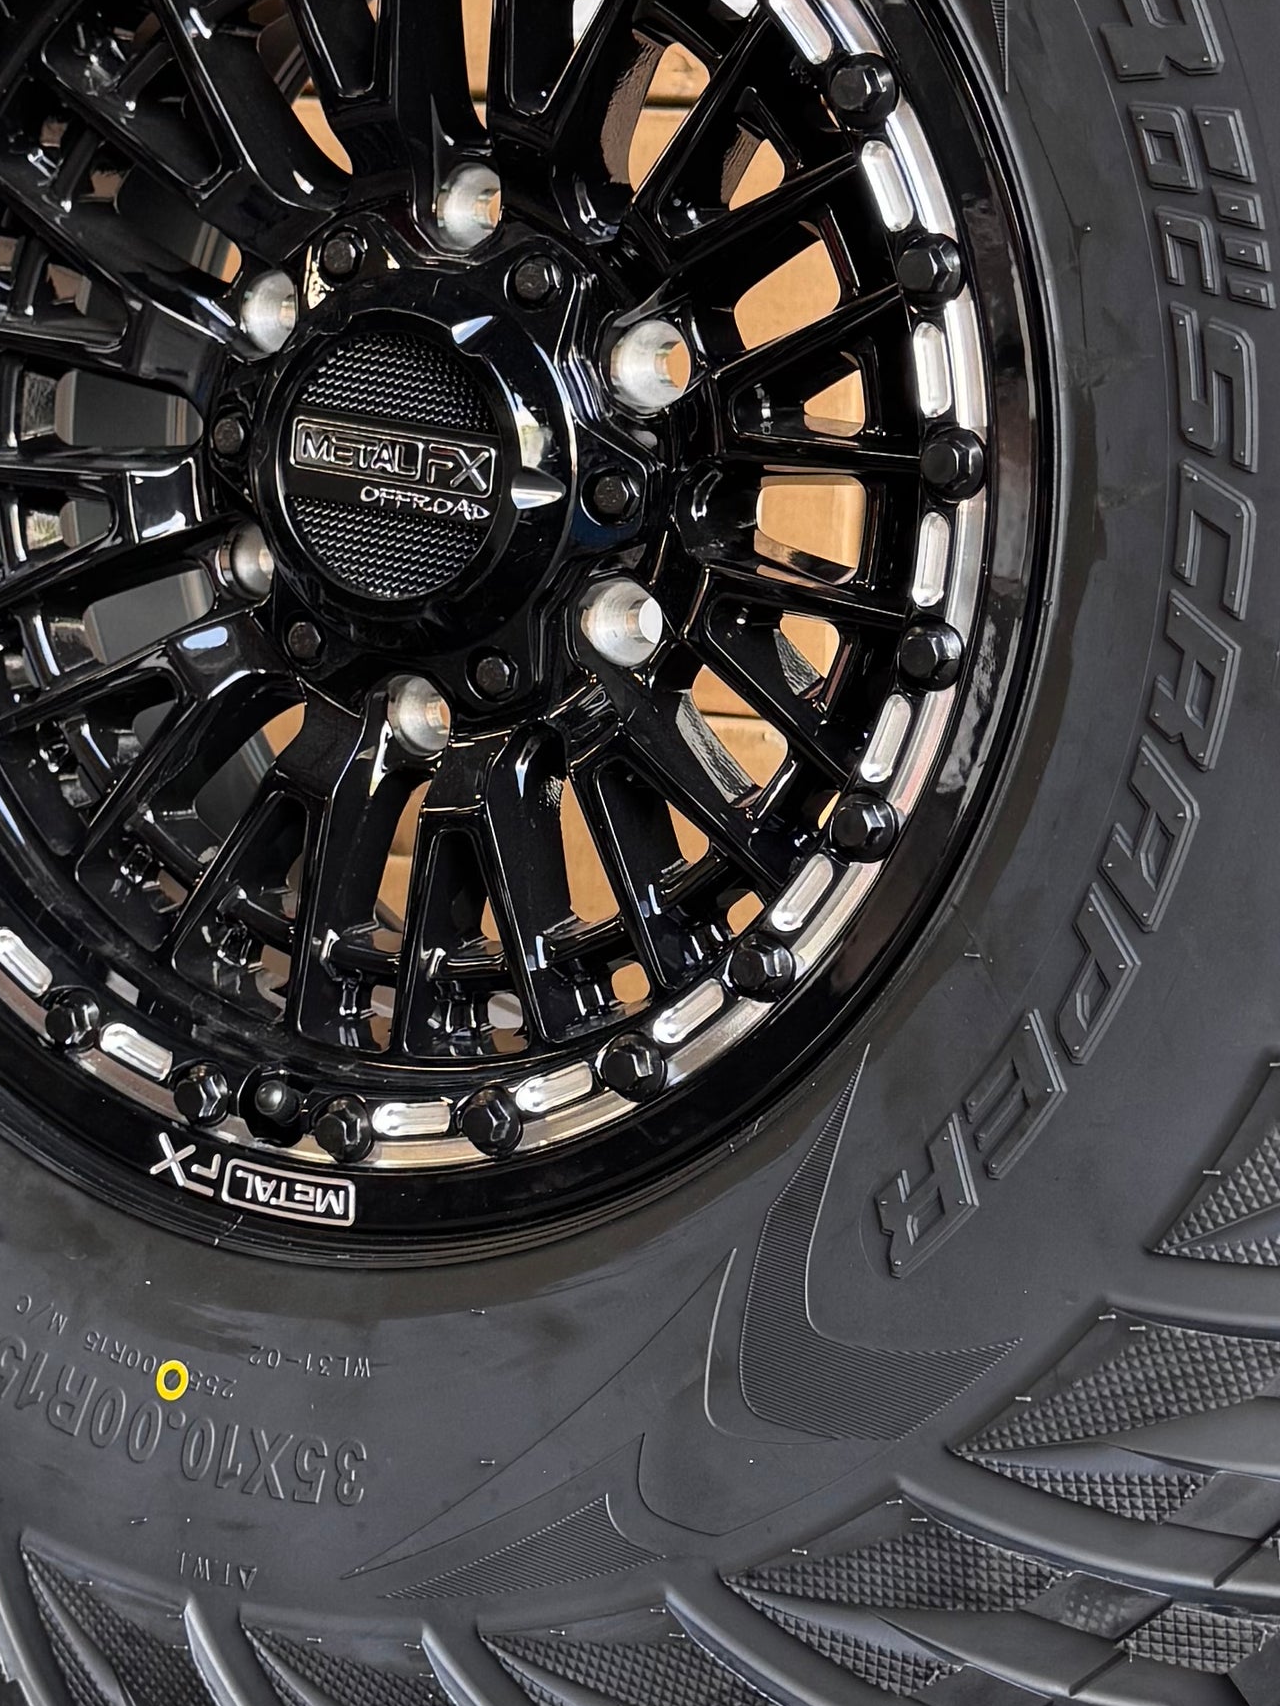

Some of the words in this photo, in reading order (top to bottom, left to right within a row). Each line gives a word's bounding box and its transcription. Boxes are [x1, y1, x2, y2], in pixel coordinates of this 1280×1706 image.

[302, 430, 417, 477] METAL
[426, 443, 491, 492] FX
[360, 485, 491, 521] OFFROAD
[149, 1131, 222, 1197] FX
[235, 1169, 347, 1216] METAL
